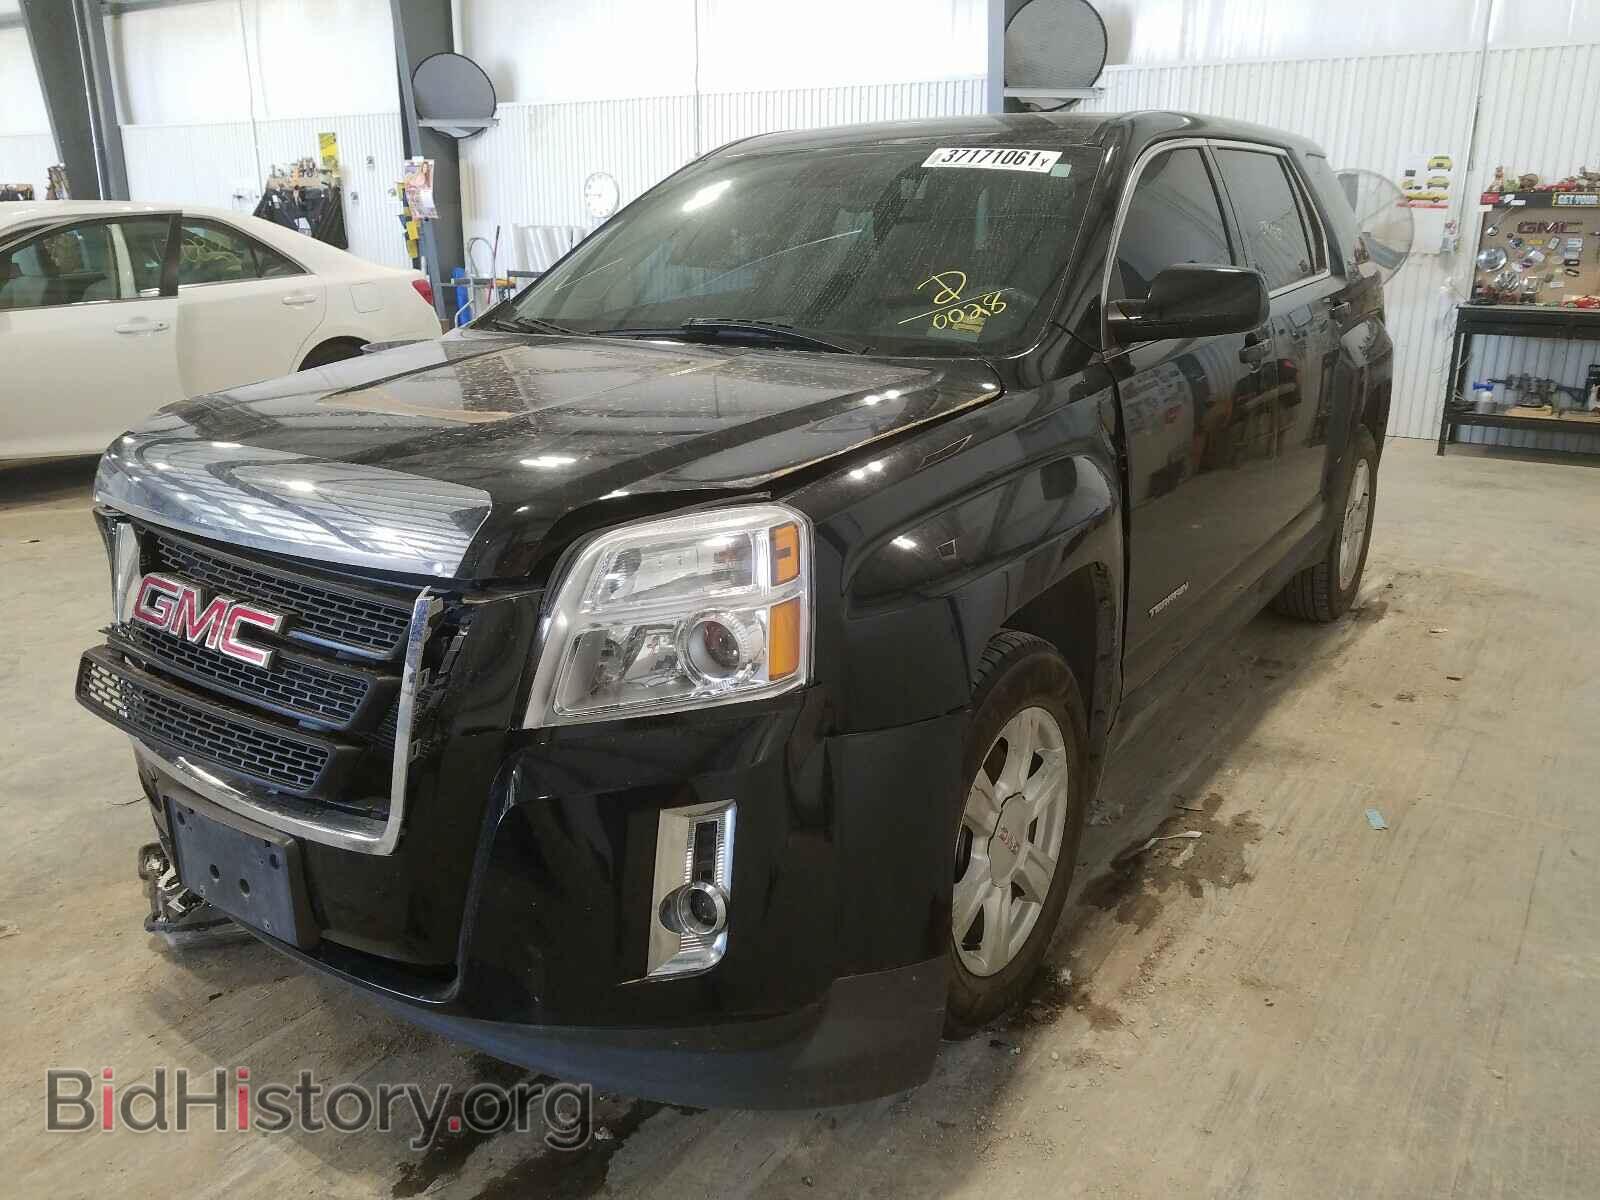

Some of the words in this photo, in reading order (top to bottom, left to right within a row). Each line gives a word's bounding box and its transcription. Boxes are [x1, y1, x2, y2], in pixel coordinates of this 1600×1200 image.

[941, 149, 1042, 167] 37171061
[1517, 221, 1583, 234] GMC
[932, 291, 1008, 330] 0028
[132, 572, 285, 669] GMC
